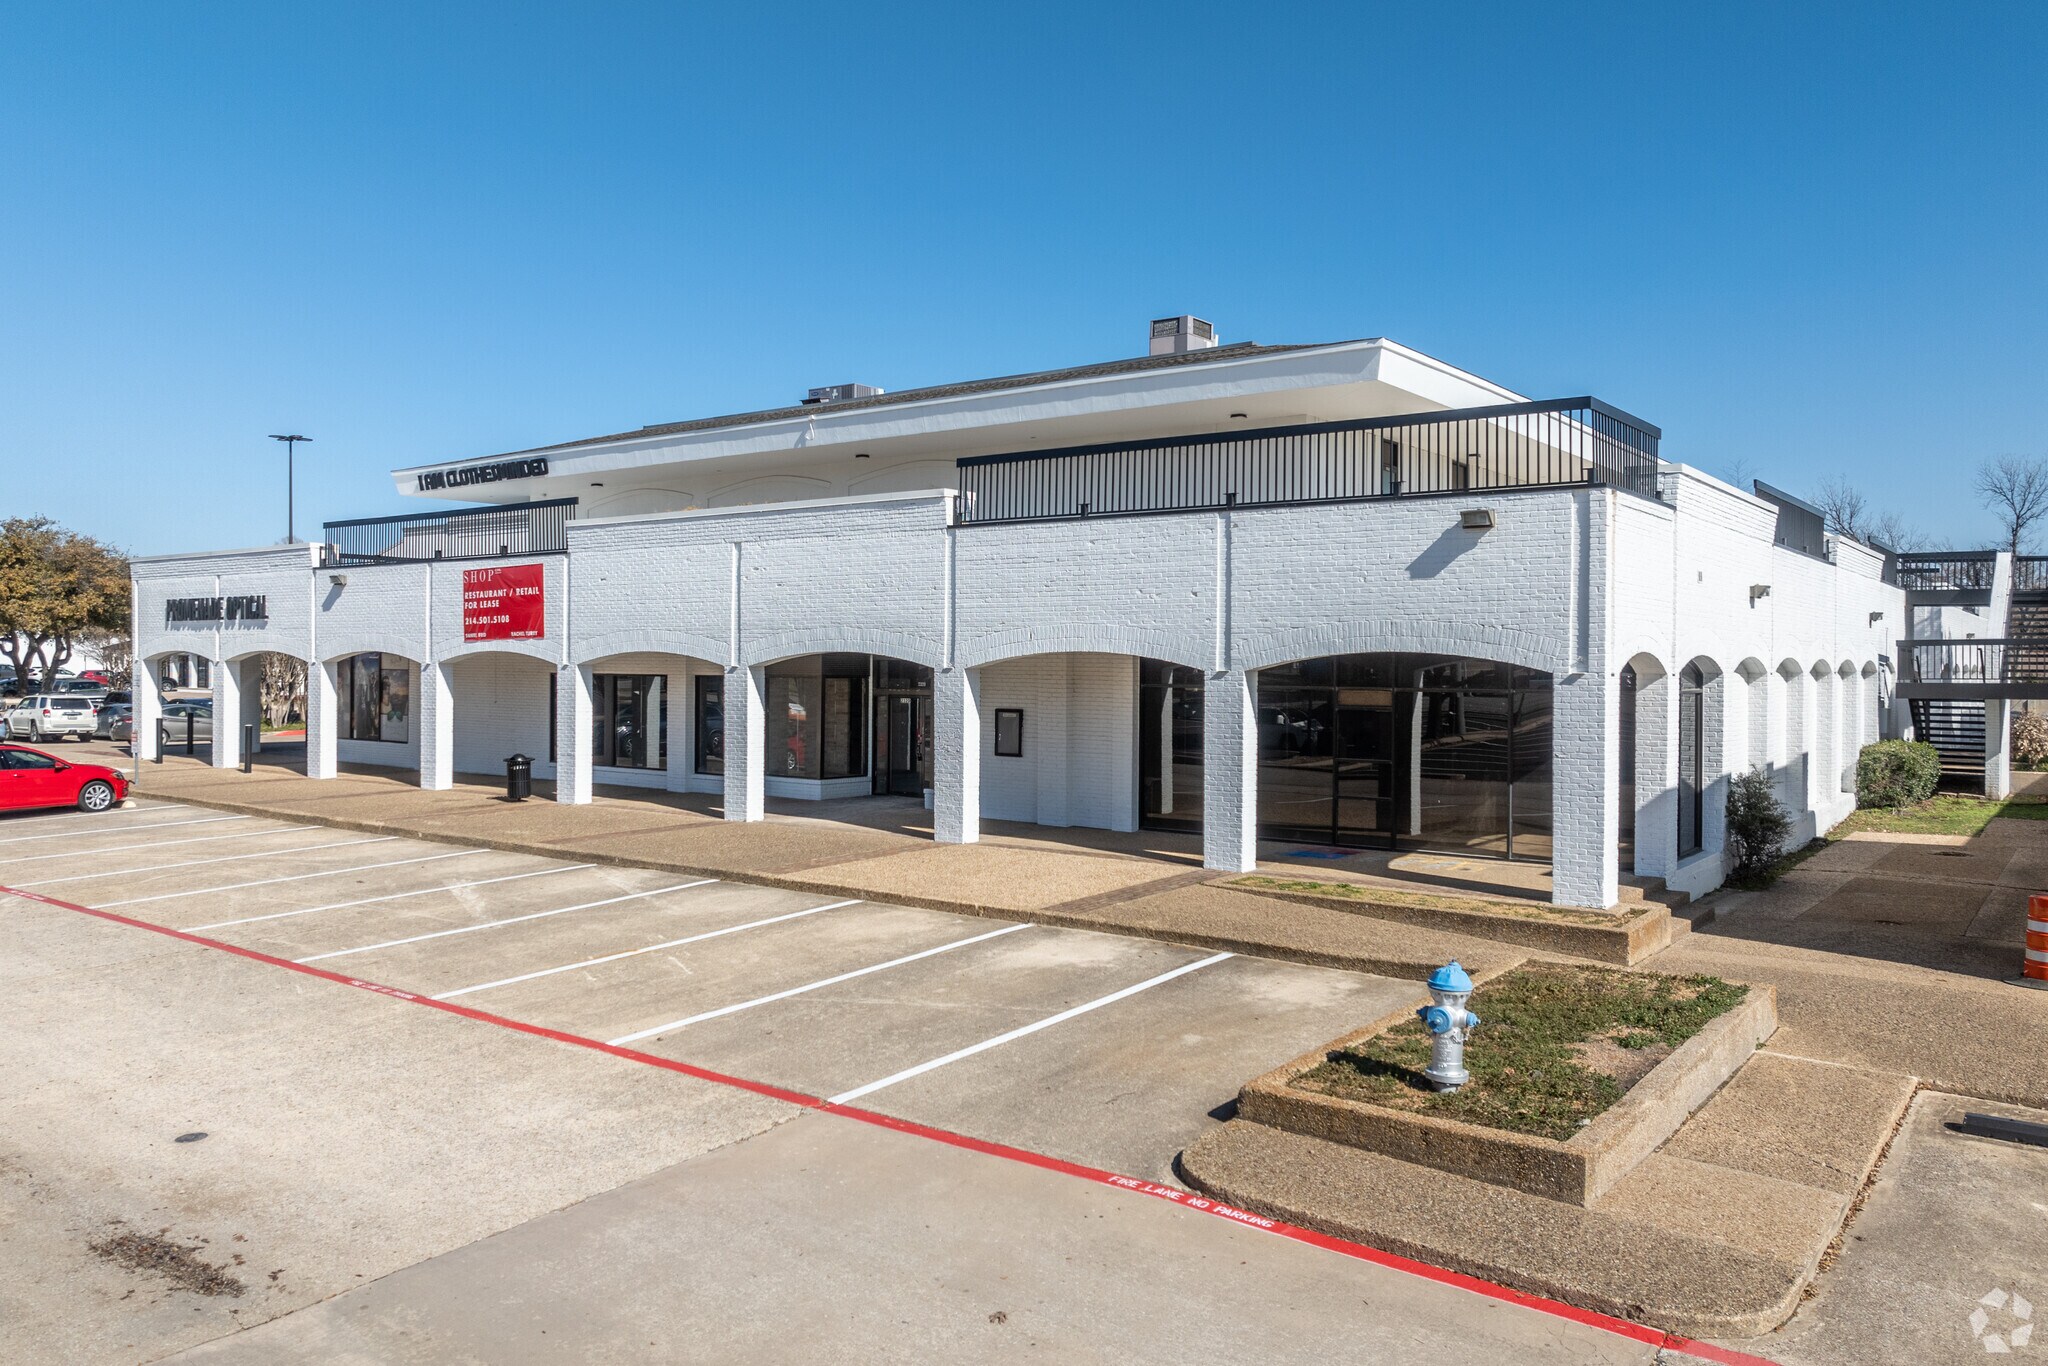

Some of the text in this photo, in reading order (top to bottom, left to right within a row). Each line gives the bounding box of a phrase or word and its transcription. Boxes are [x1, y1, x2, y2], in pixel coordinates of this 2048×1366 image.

[417, 475, 424, 491] I
[425, 472, 446, 490] AM
[463, 569, 494, 584] SHOP
[464, 589, 507, 600] RESTAURANT
[516, 586, 540, 596] RETAIL
[166, 595, 269, 621] PROMENADE OPTICAL
[464, 599, 500, 610] FOR LEASE
[465, 615, 510, 625] 214.501.5108
[1108, 1175, 1276, 1229] FIRE LANE NO PARKING
